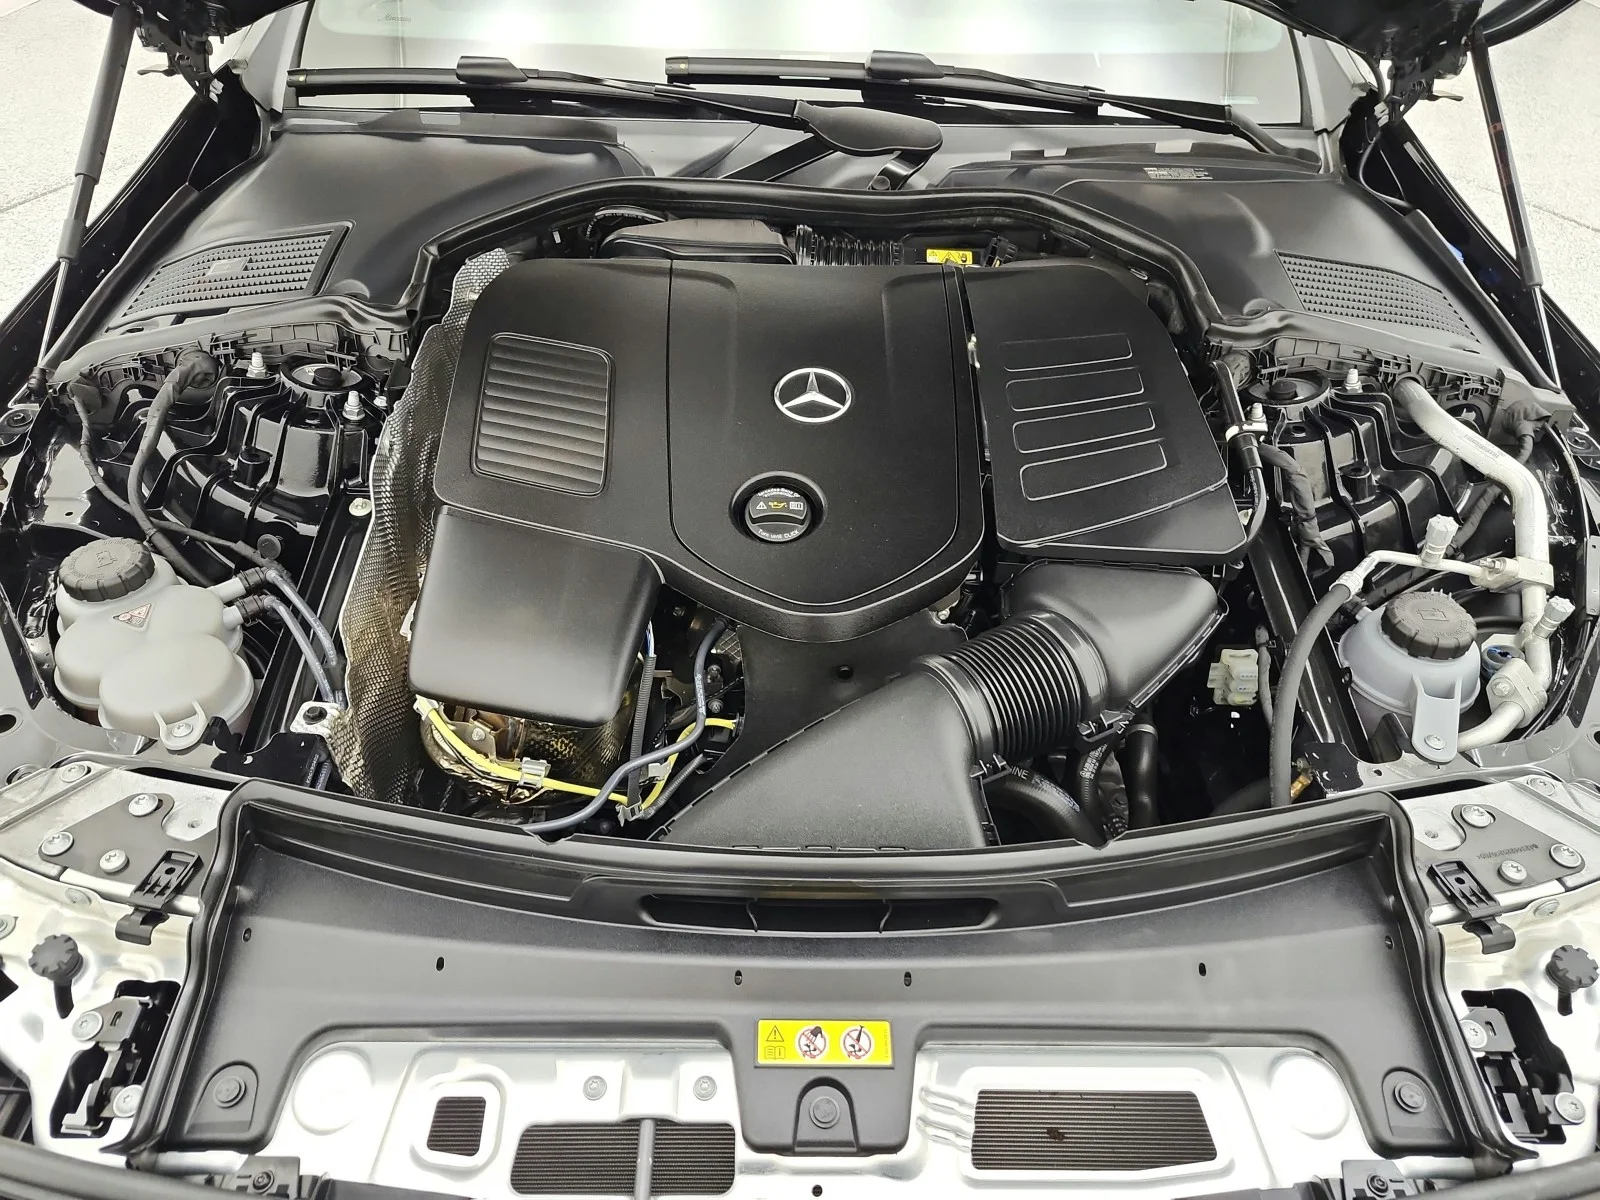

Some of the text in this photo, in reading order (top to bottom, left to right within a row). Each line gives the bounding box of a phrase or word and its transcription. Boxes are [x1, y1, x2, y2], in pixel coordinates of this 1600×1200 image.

[758, 529, 769, 537] Turn
[784, 529, 799, 538] CLICK
[1010, 765, 1030, 781] INE
